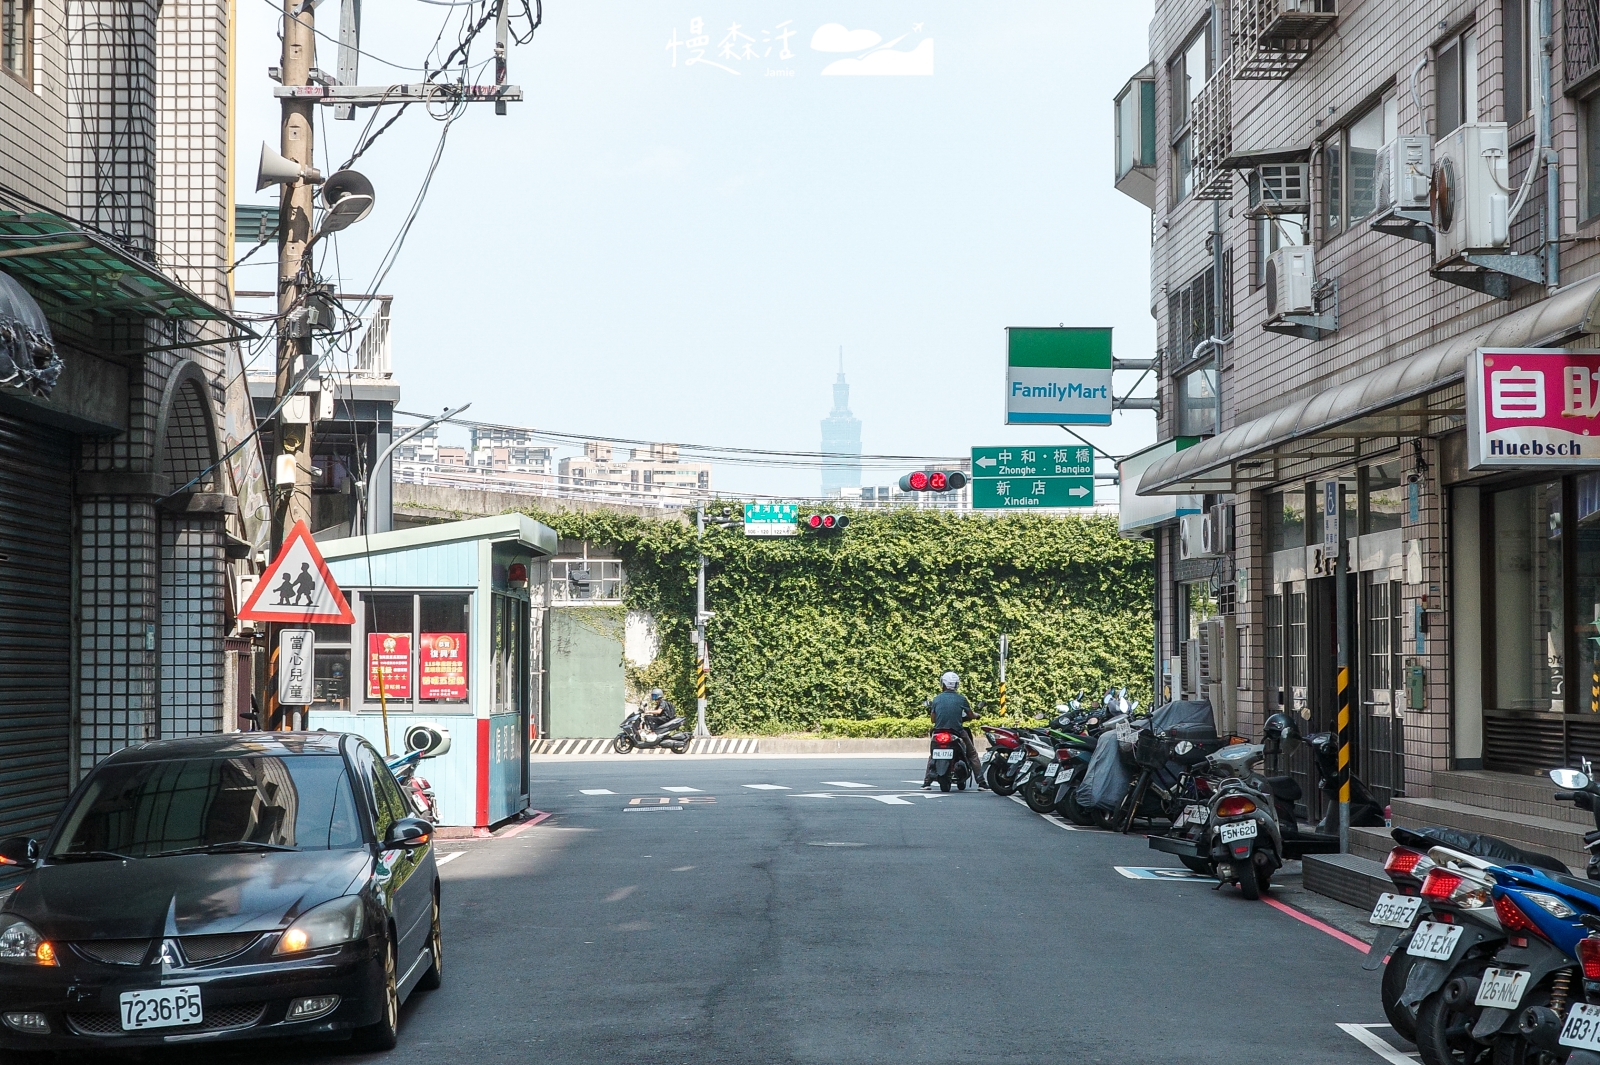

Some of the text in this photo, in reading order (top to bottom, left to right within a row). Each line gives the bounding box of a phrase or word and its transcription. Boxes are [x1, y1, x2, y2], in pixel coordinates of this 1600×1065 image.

[1012, 382, 1107, 401] FamilyMart
[1490, 440, 1581, 455] Huebsch
[998, 464, 1090, 476] Zhonghe Banqiao
[996, 480, 1046, 496] 新店
[1004, 497, 1039, 505] Xindian
[289, 636, 304, 698] 當心兒童
[122, 994, 201, 1024] 7236-P5
[1562, 1017, 1600, 1043] AB3-1
